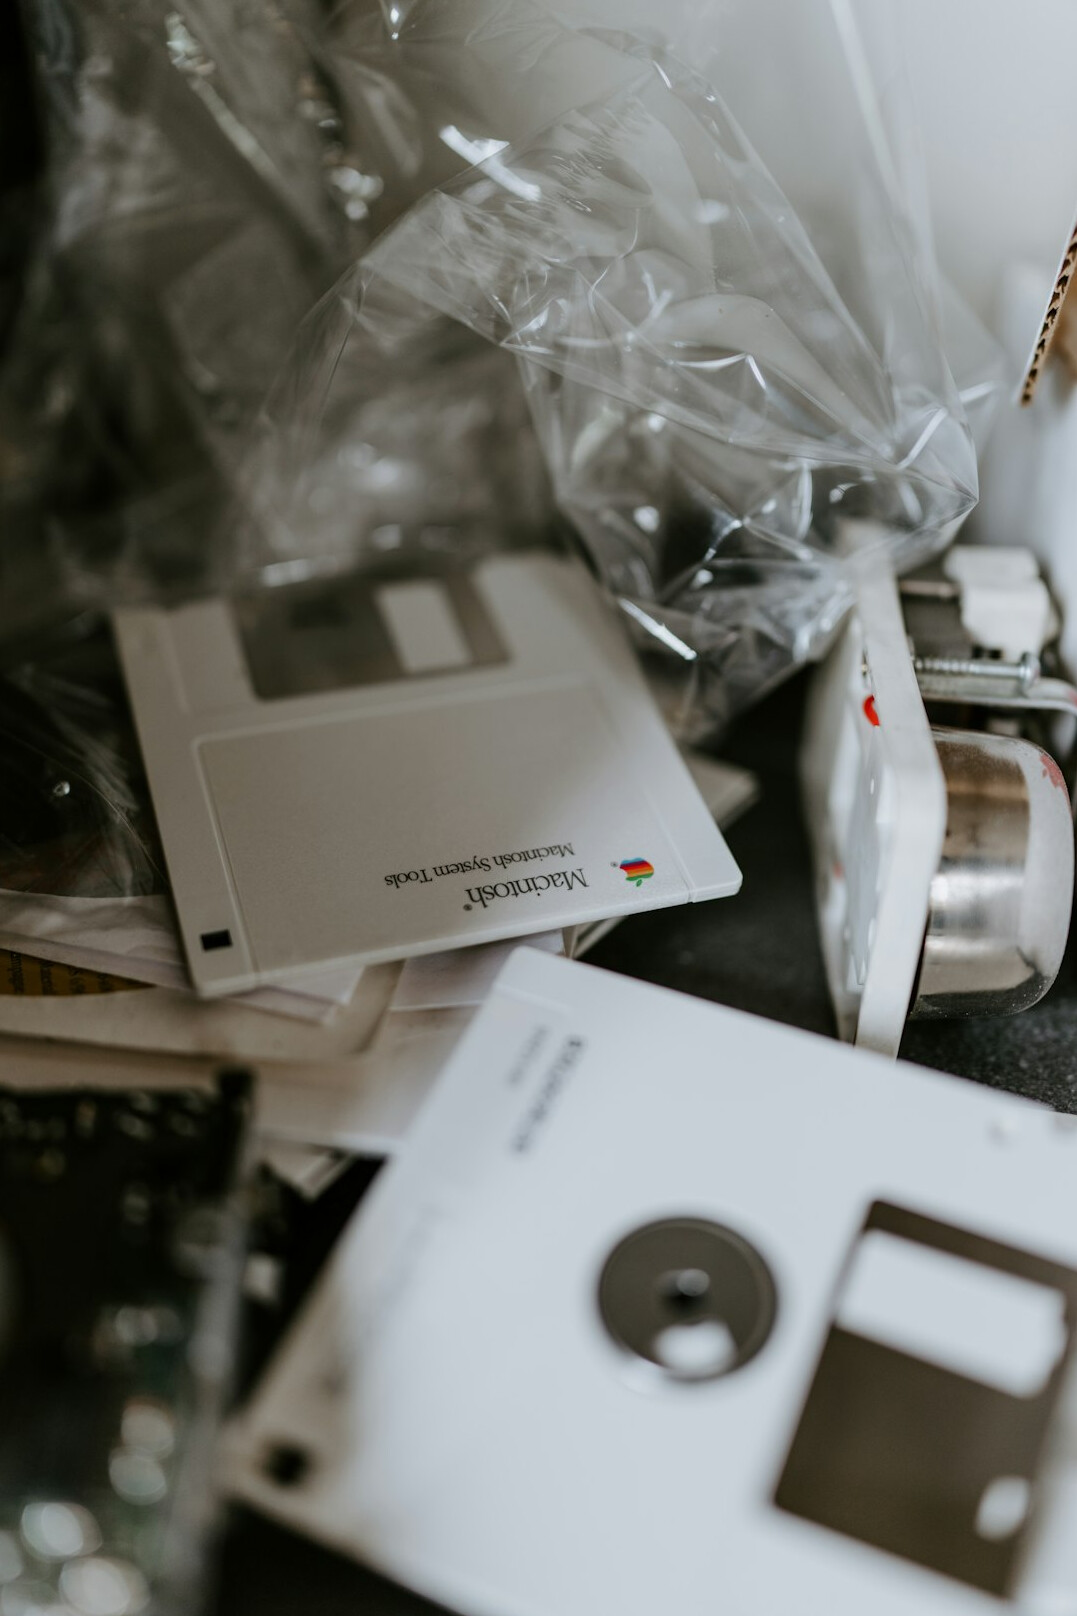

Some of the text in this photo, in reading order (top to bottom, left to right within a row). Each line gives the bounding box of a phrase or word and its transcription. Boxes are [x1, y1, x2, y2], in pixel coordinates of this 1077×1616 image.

[384, 843, 575, 889] Macintosh System Tools
